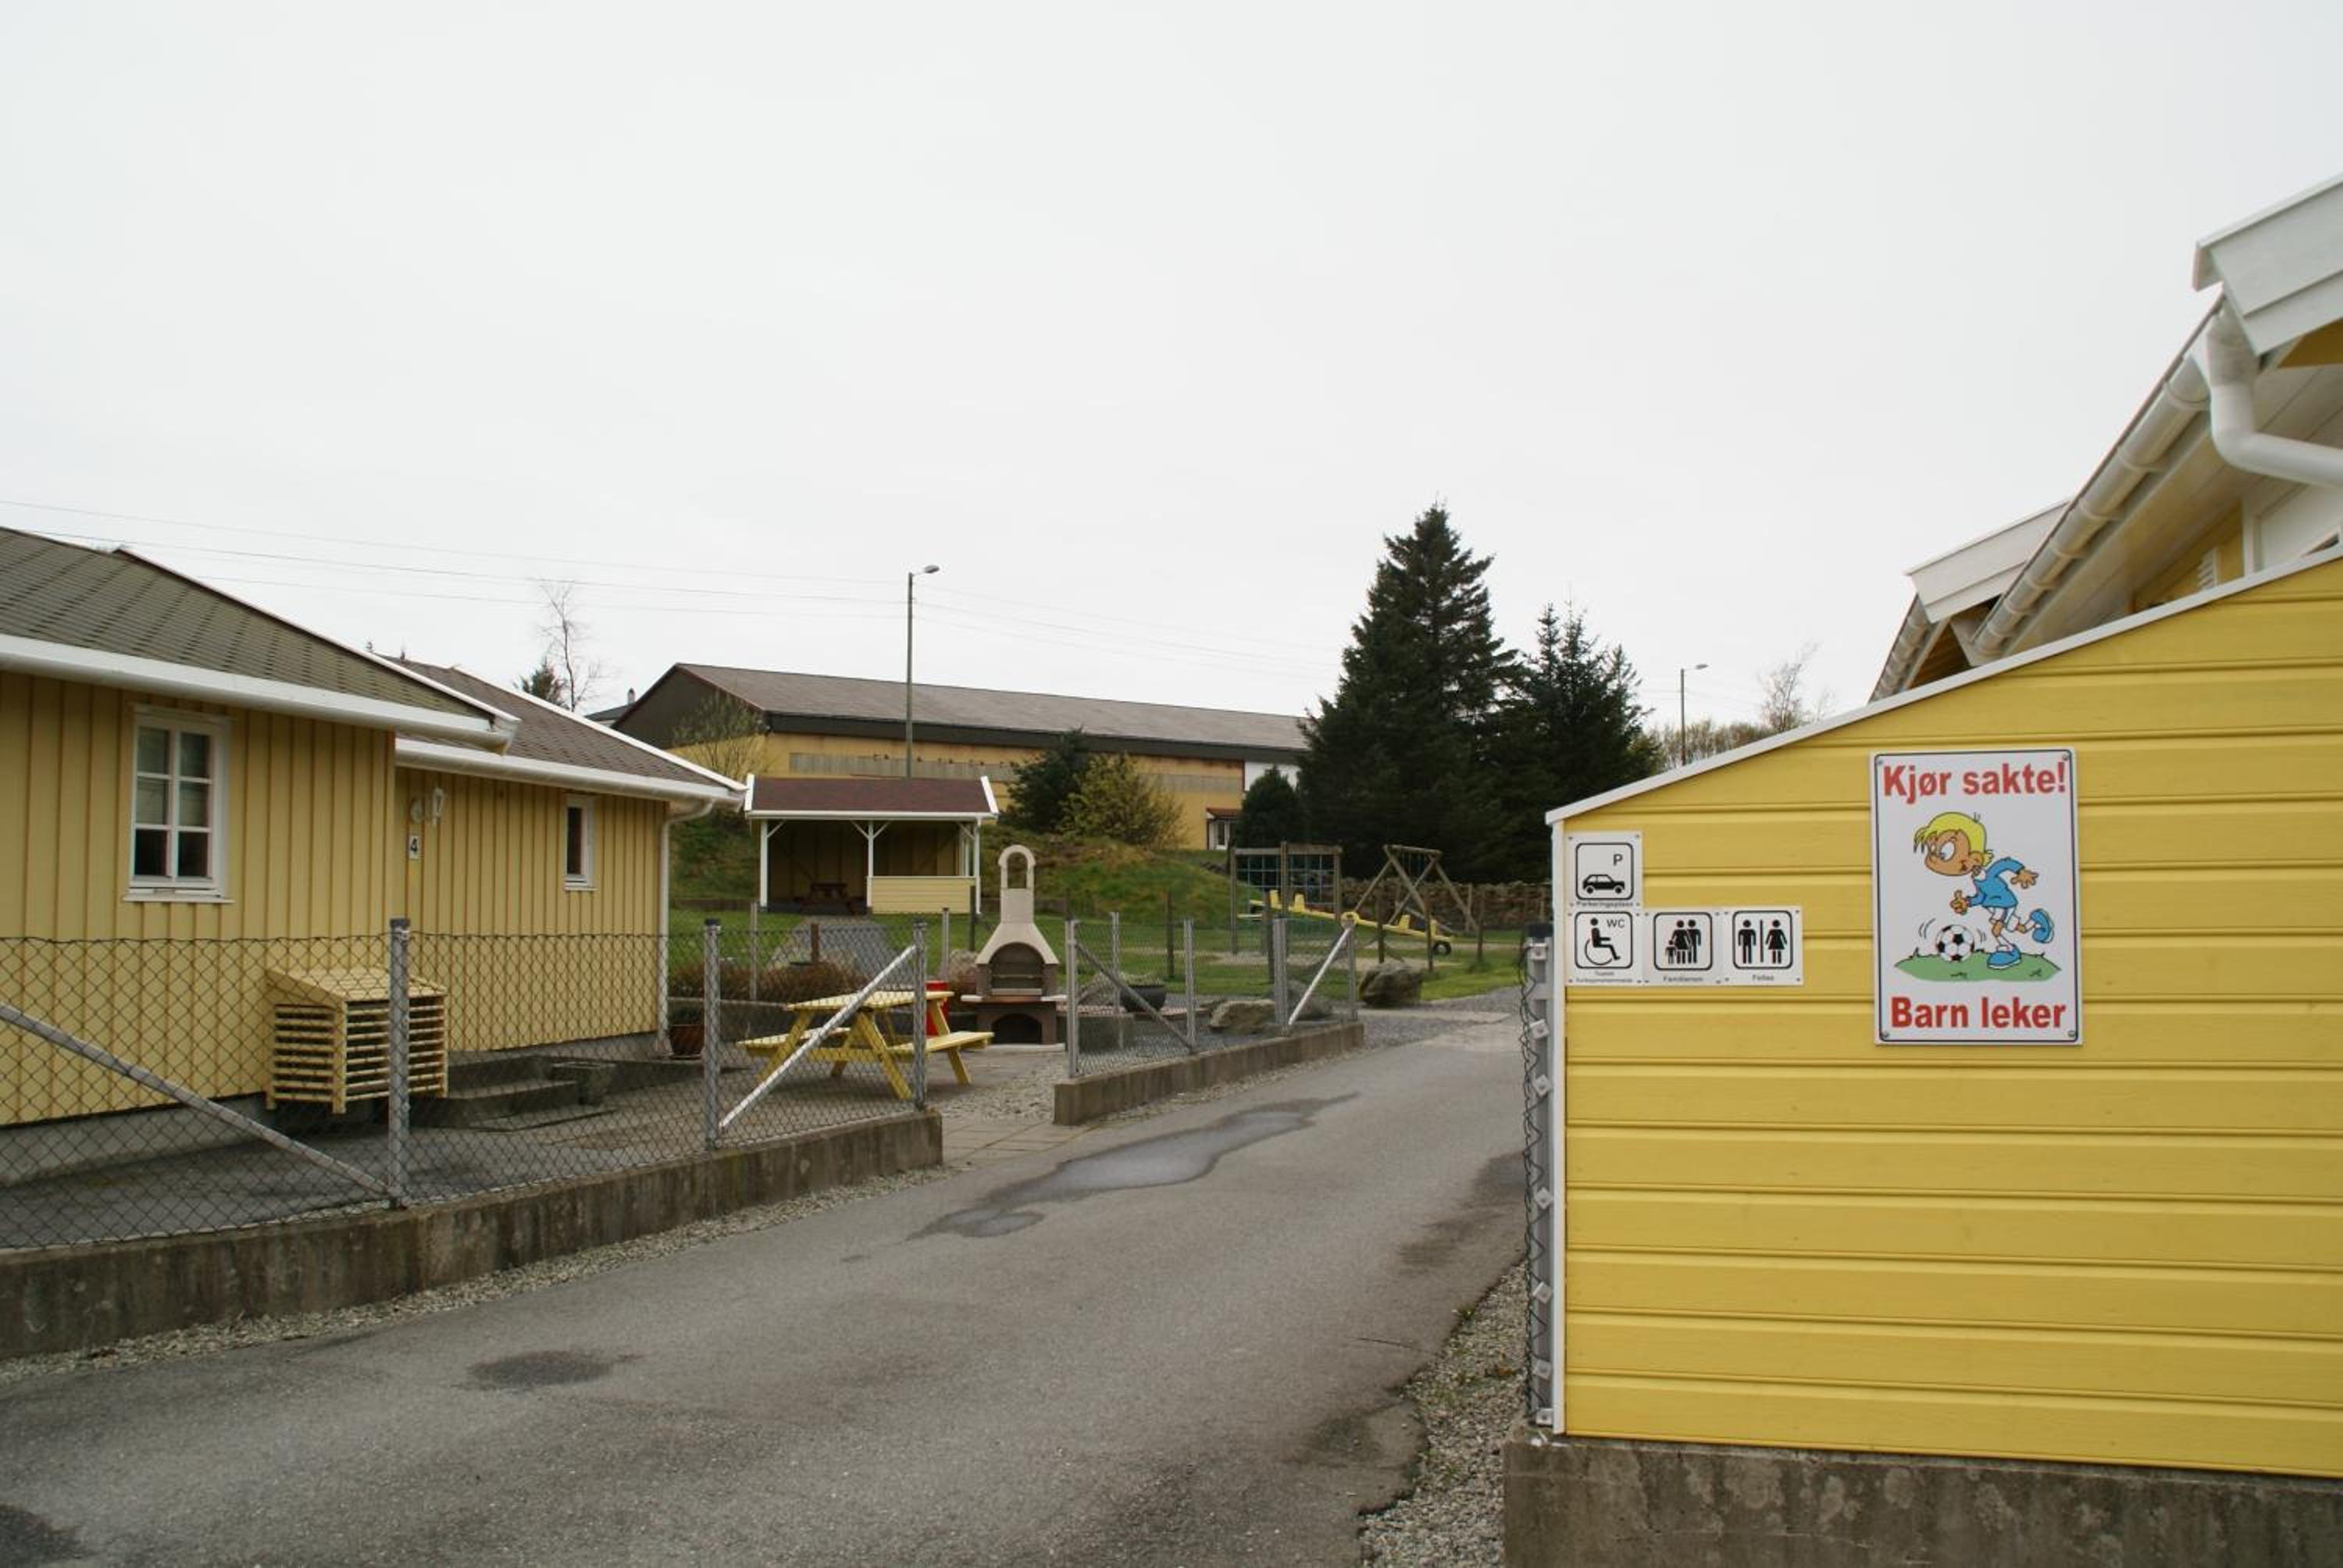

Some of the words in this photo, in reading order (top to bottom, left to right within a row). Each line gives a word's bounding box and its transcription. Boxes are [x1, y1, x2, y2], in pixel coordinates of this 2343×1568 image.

[1883, 765, 1952, 804] Kjør
[1963, 762, 2066, 796] sakte!
[410, 837, 418, 854] 4
[1613, 854, 1623, 866] P
[1607, 919, 1625, 928] WC
[1891, 997, 1968, 1028] Barn
[1981, 996, 2067, 1028] leker
